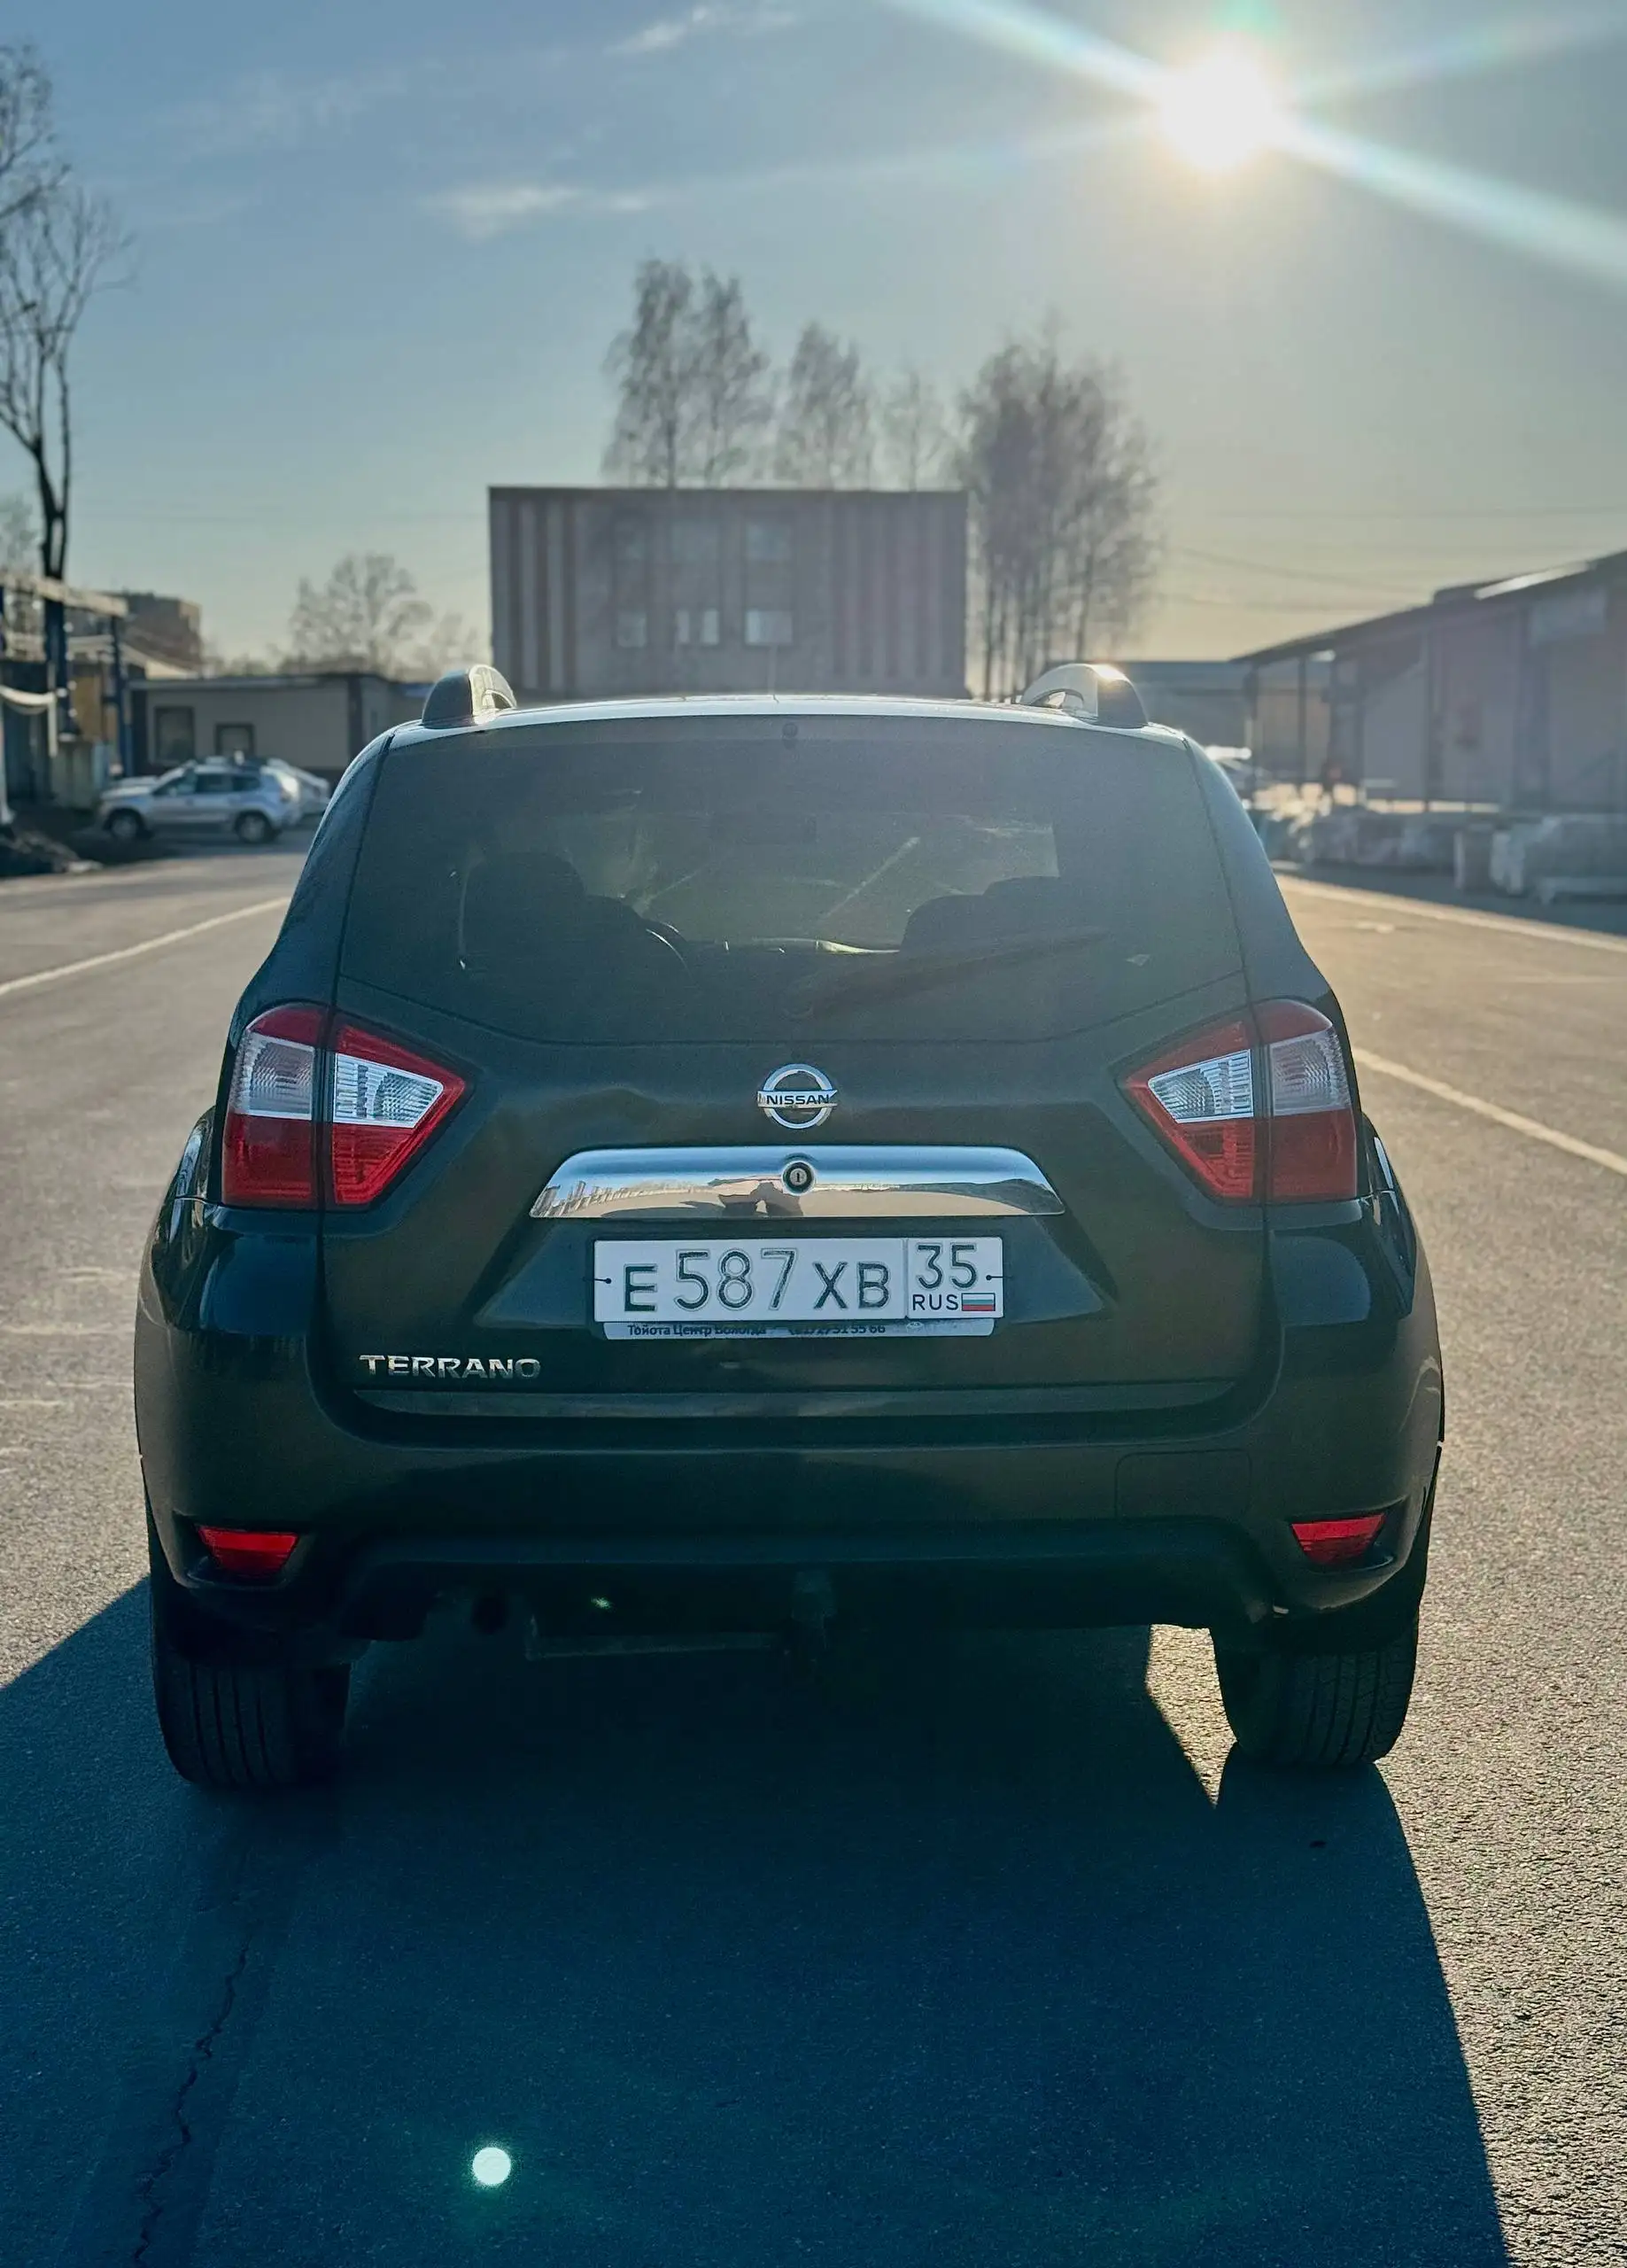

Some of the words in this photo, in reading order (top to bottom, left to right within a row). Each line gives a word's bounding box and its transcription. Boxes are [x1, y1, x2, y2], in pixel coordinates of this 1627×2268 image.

[766, 1094, 830, 1105] NISSAN
[916, 1243, 978, 1290] 35
[912, 1293, 959, 1311] RUS
[627, 1324, 671, 1335] Тойота
[359, 1355, 541, 1379] TERRANO
